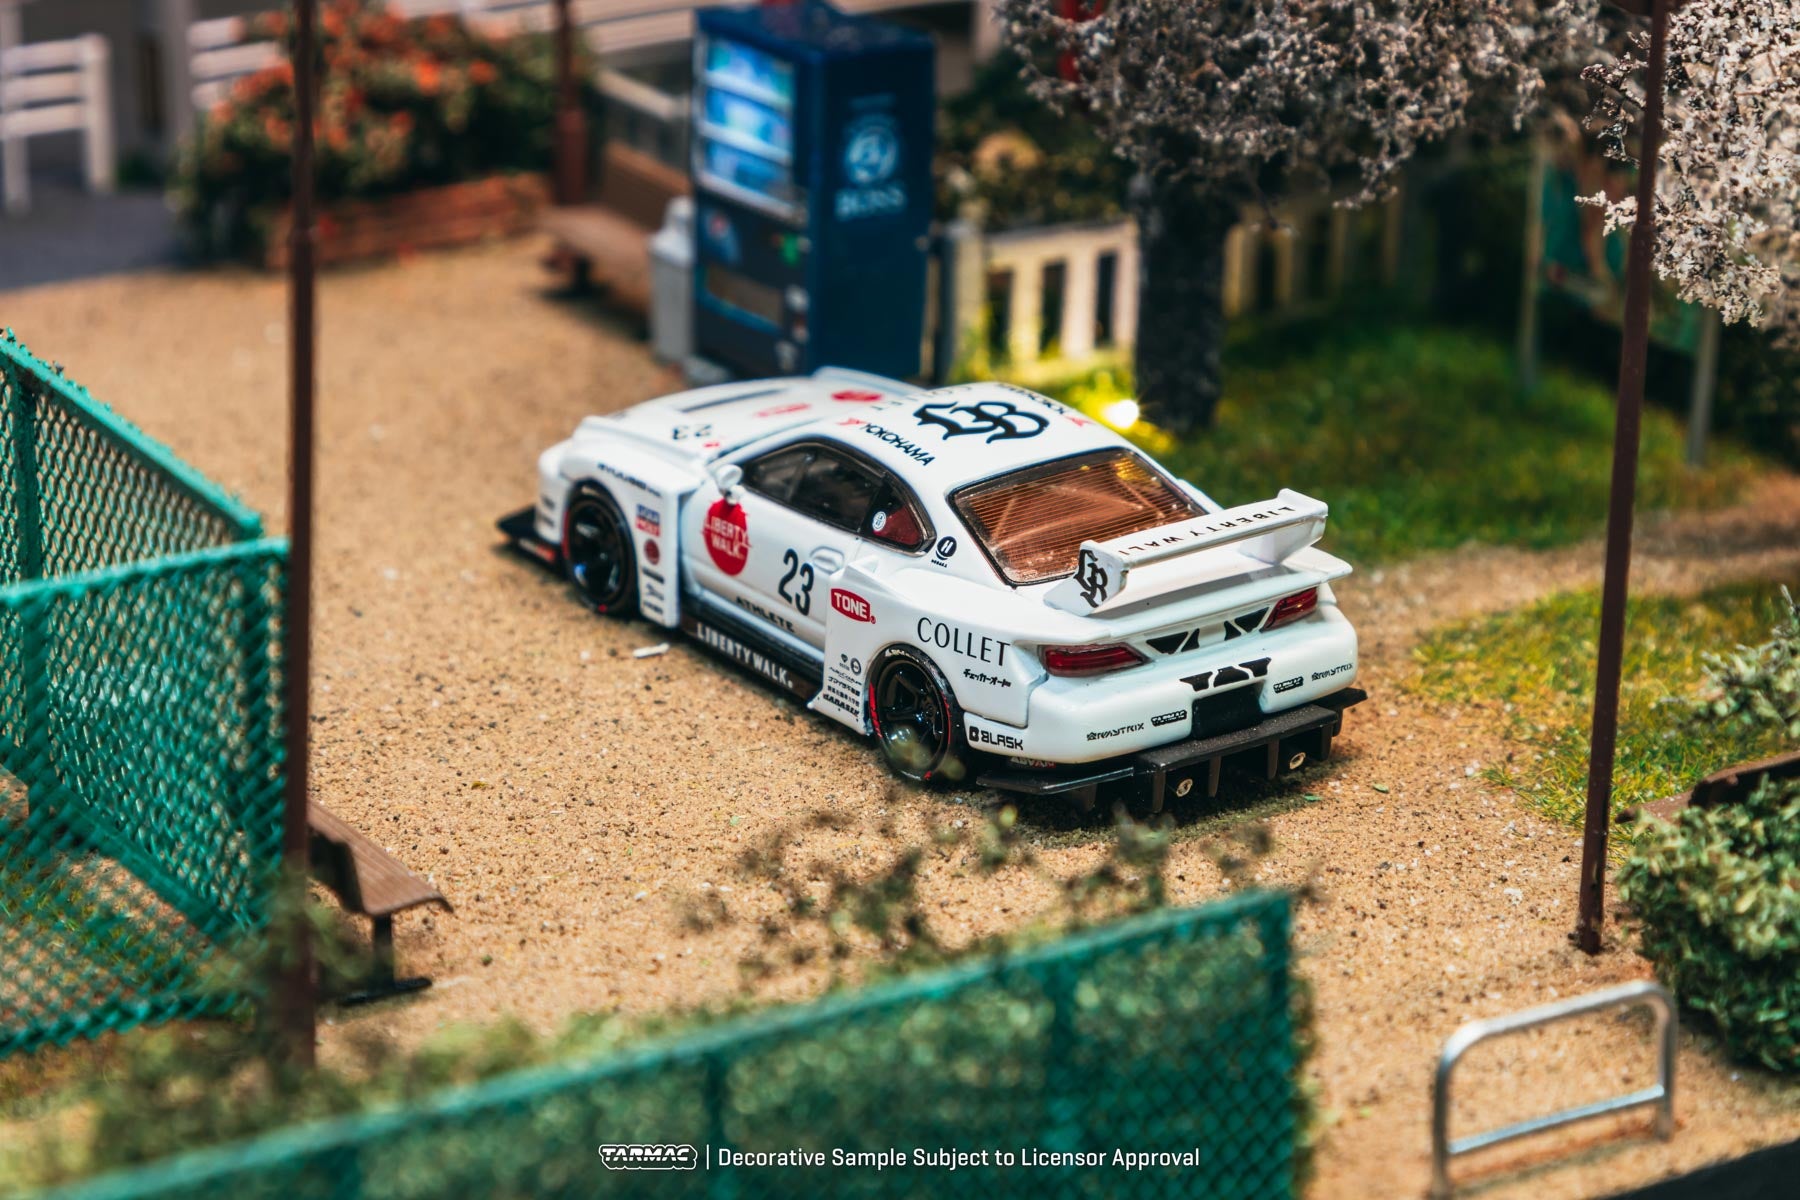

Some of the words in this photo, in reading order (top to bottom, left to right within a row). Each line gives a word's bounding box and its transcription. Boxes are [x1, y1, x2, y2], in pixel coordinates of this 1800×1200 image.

[703, 516, 752, 548] LIBERTY
[778, 549, 815, 616] 23
[834, 592, 868, 619] TONE
[917, 617, 1010, 667] COLLET
